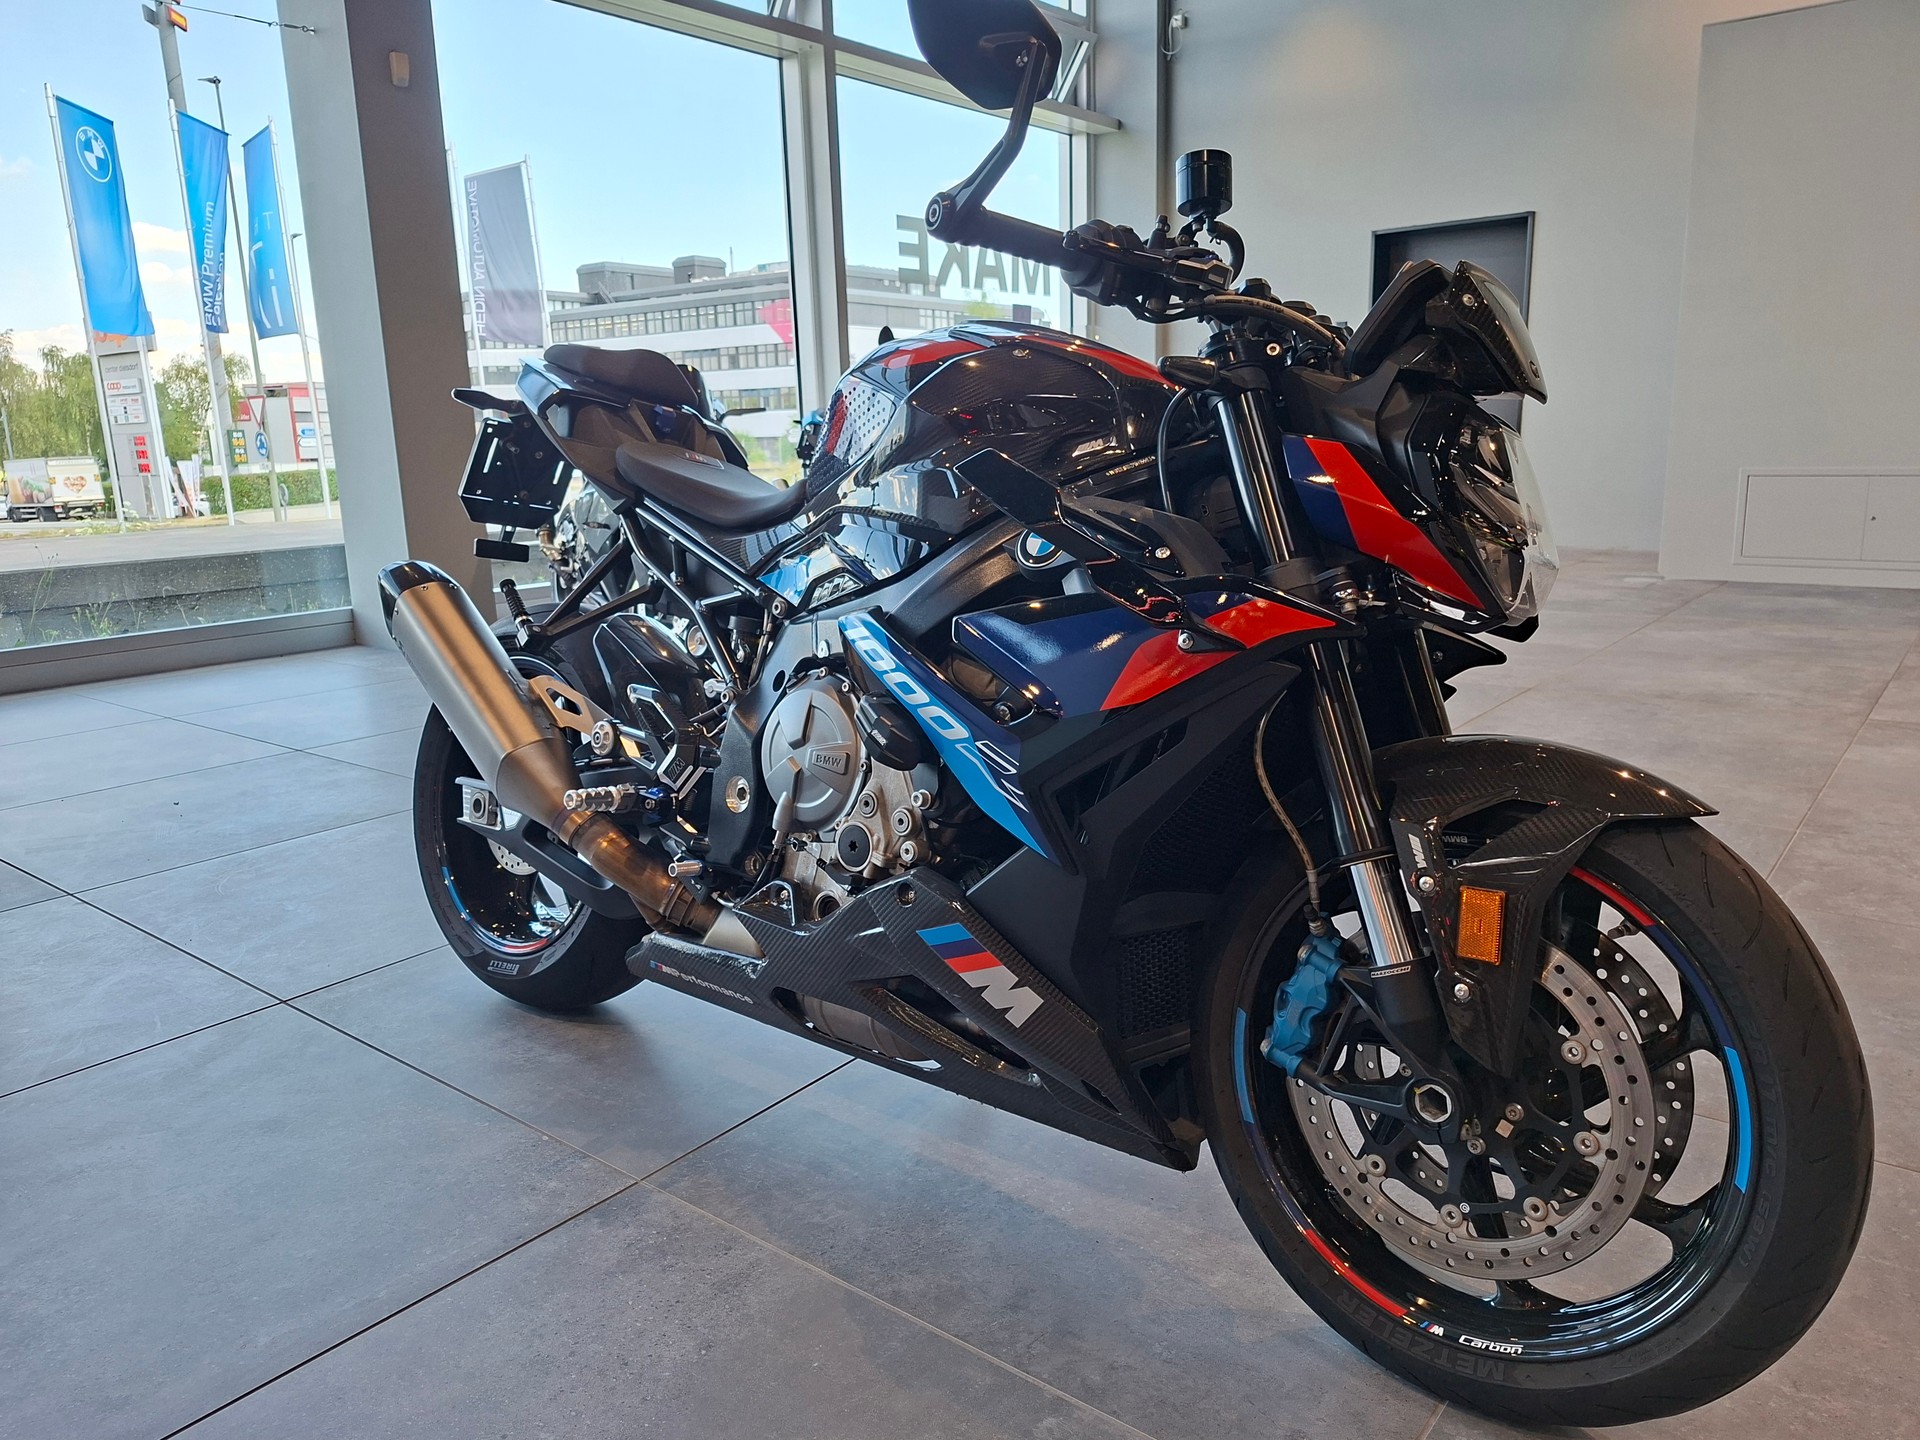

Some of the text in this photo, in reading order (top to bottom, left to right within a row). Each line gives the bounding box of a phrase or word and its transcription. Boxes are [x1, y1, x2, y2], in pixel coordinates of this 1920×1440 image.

[79, 130, 105, 149] BMW
[202, 201, 214, 326] BMW Premium
[844, 627, 970, 740] 1000
[816, 754, 842, 768] BMW
[487, 960, 520, 975] PIRELLI
[671, 967, 754, 1005] Performance
[1337, 1290, 1505, 1382] METZELER
[1458, 1335, 1524, 1355] Carbon
